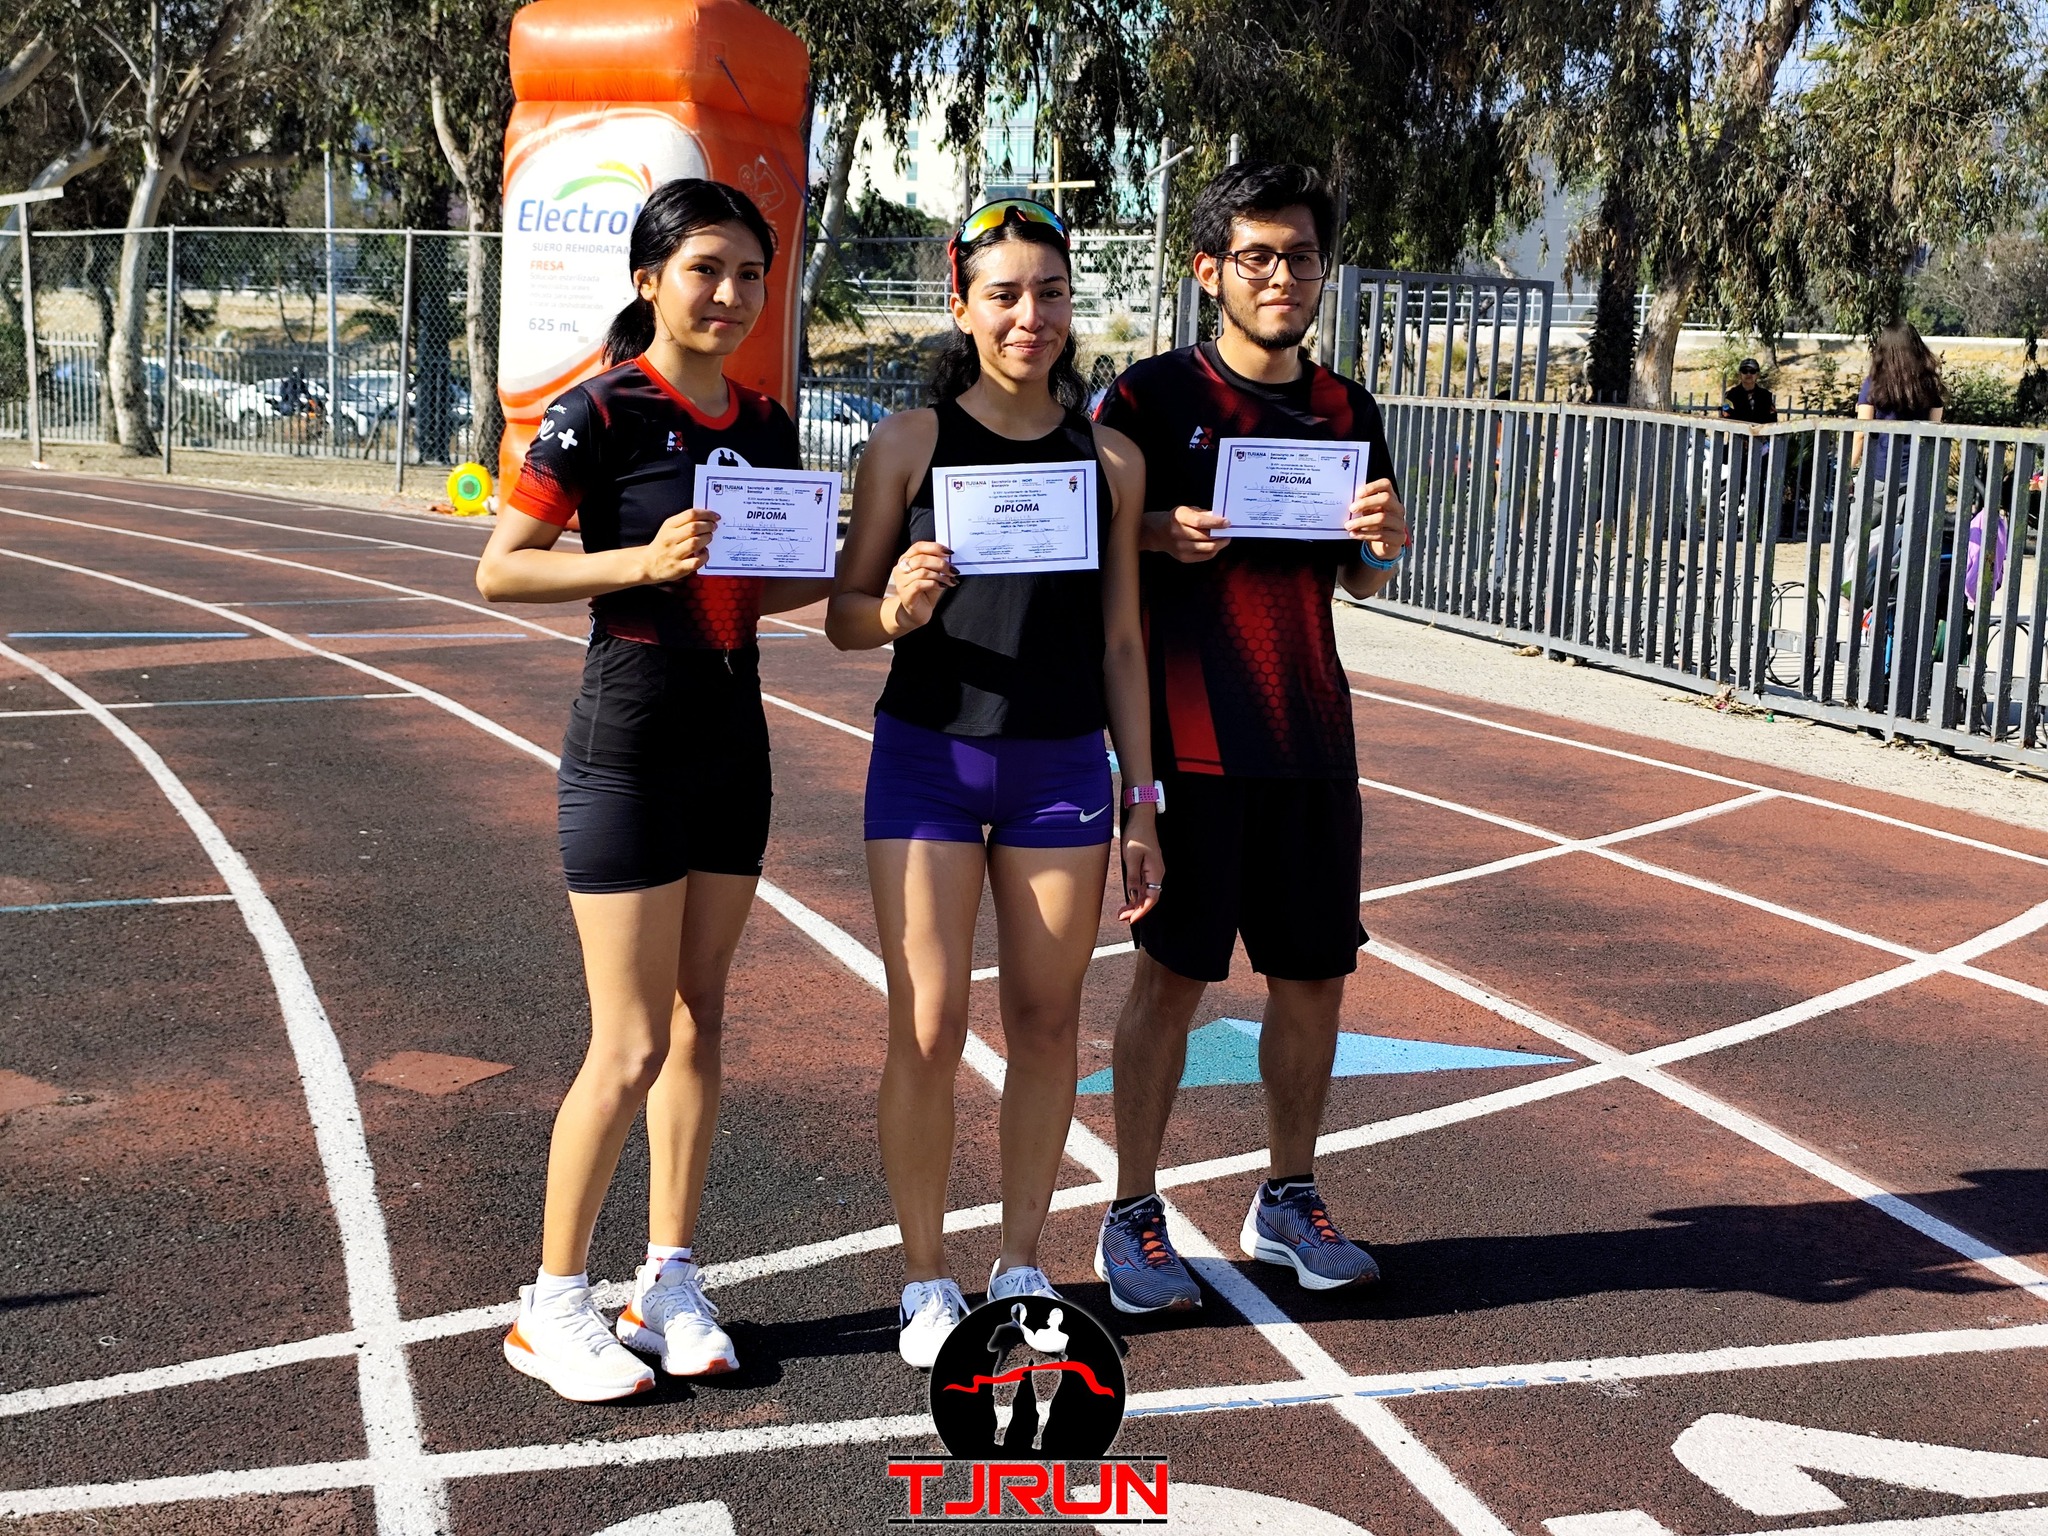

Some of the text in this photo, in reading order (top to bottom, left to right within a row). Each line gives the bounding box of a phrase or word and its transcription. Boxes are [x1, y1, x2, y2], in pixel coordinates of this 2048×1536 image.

[532, 242, 563, 253] SUERO
[530, 260, 565, 271] FRESA
[529, 318, 579, 333] 625 mL
[1269, 475, 1312, 485] DIPLOMA
[994, 503, 1040, 513] DIPLOMA
[746, 510, 787, 521] DIPLOMA
